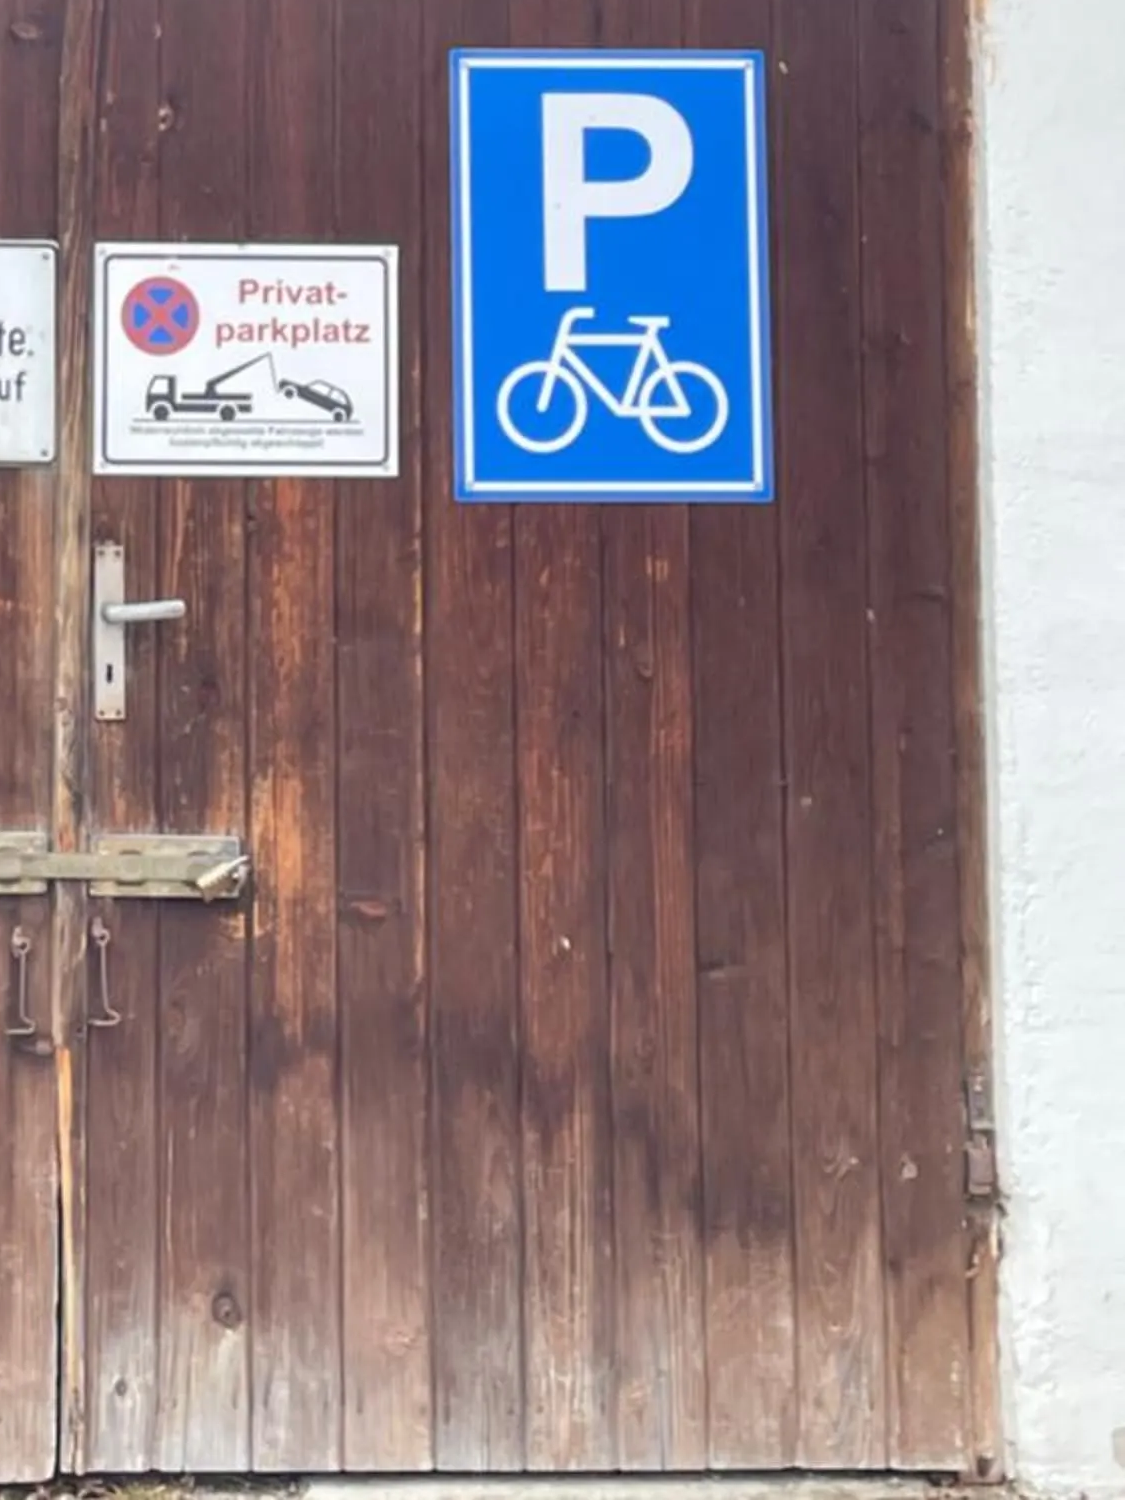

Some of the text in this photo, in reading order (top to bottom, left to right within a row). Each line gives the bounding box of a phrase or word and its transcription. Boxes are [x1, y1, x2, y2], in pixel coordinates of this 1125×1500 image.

[540, 92, 694, 292] P
[238, 278, 348, 306] Privat-
[214, 317, 371, 348] parkplatz
